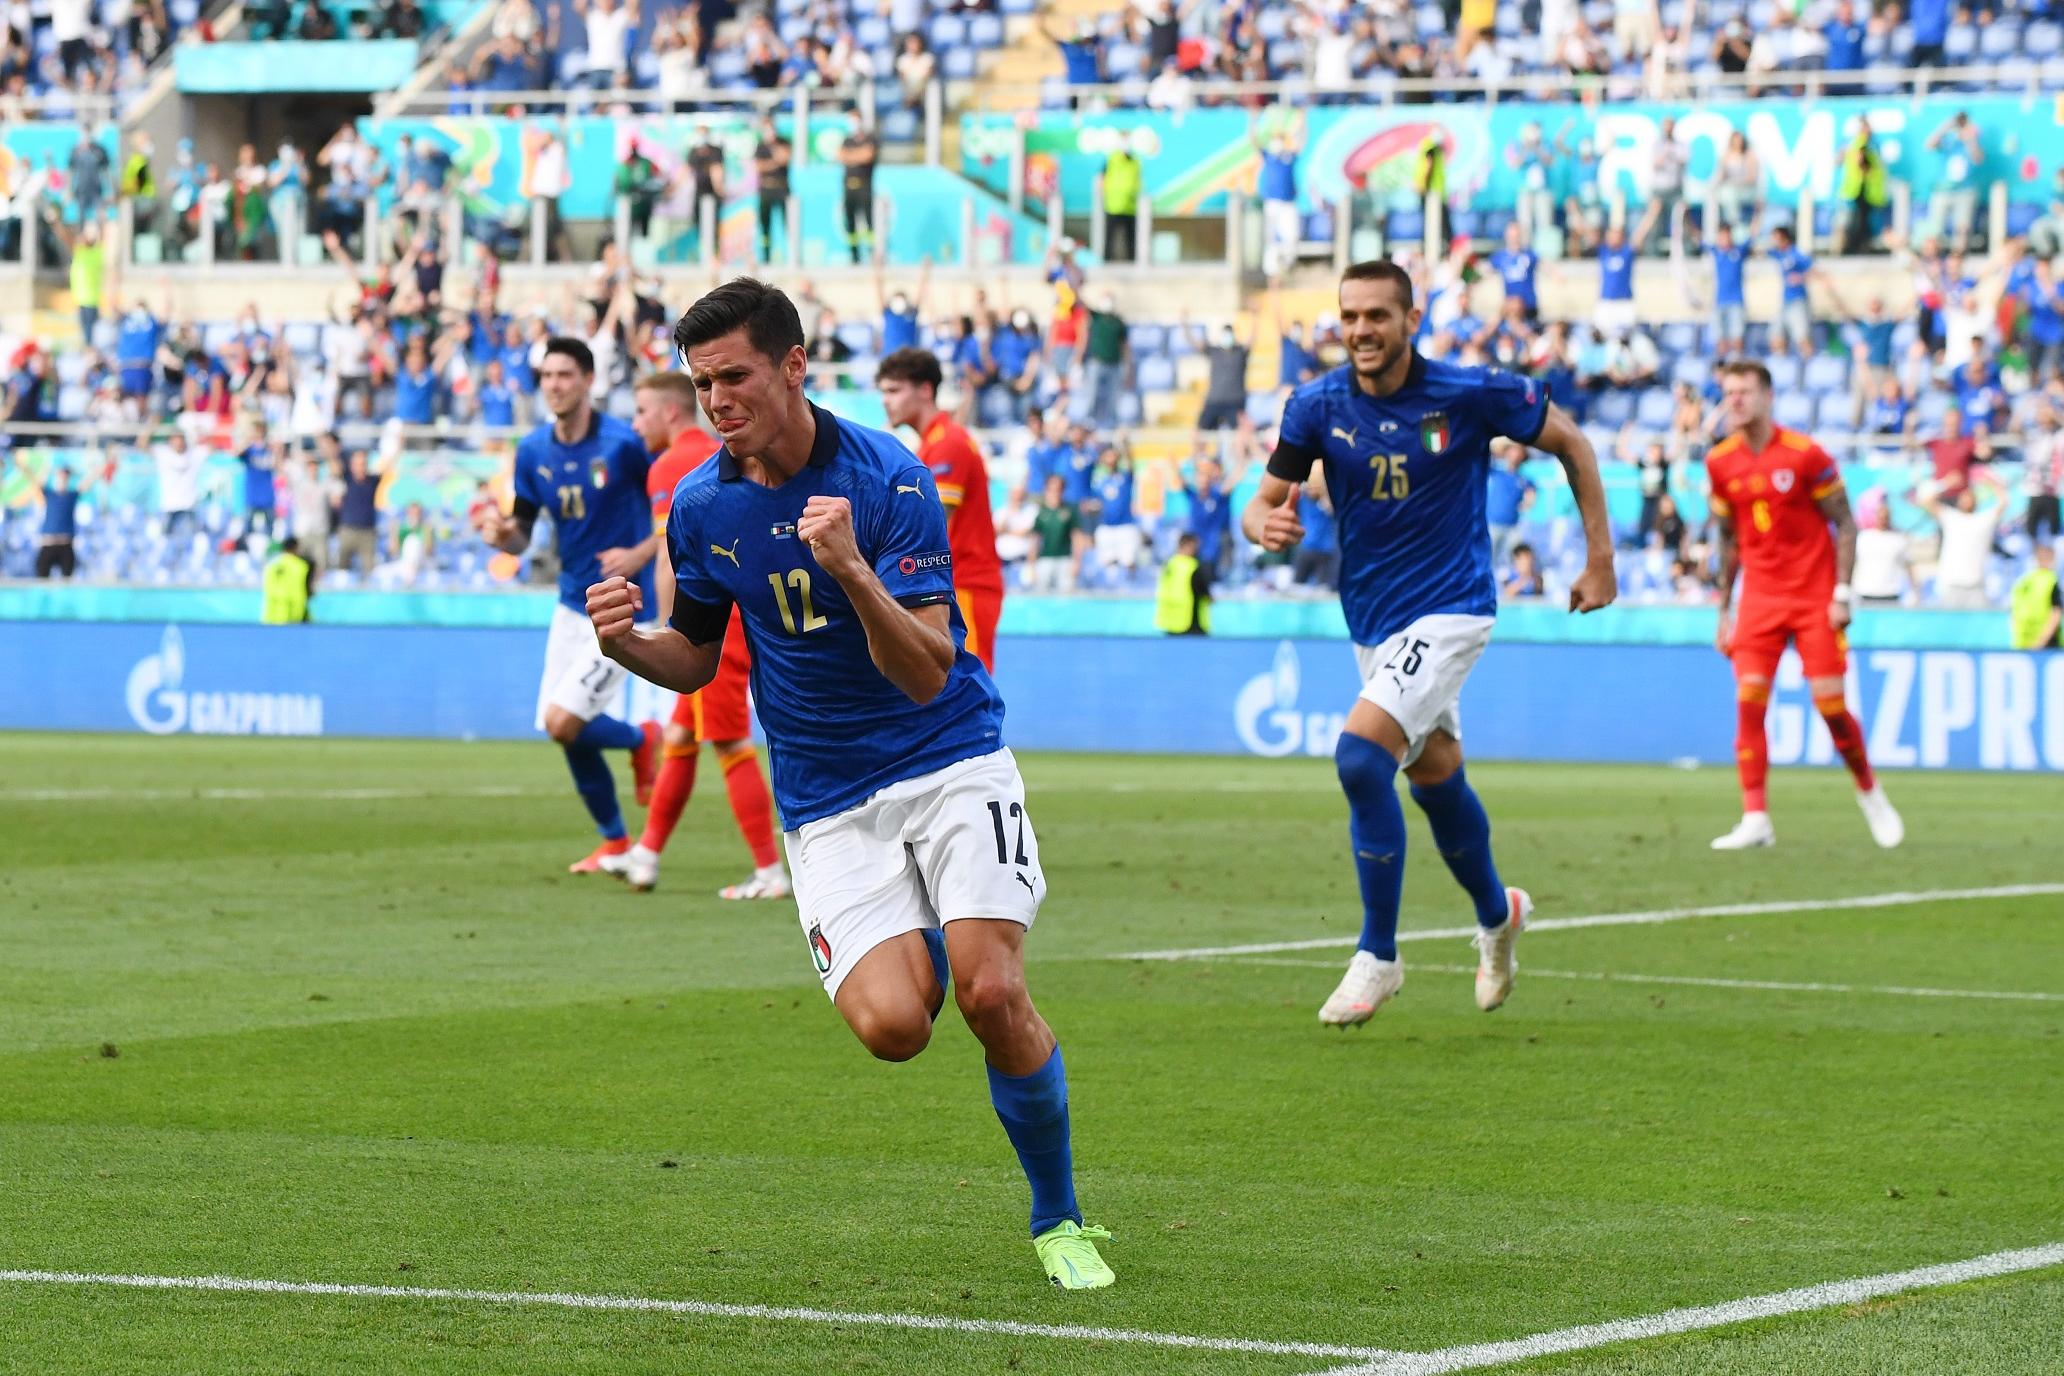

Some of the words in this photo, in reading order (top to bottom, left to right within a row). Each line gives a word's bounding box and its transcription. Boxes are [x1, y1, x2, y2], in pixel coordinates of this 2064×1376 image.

[1369, 454, 1409, 500] 25
[916, 554, 951, 568] RESPECT
[767, 568, 828, 635] 12
[1383, 636, 1430, 676] 25
[986, 800, 1029, 866] 12
